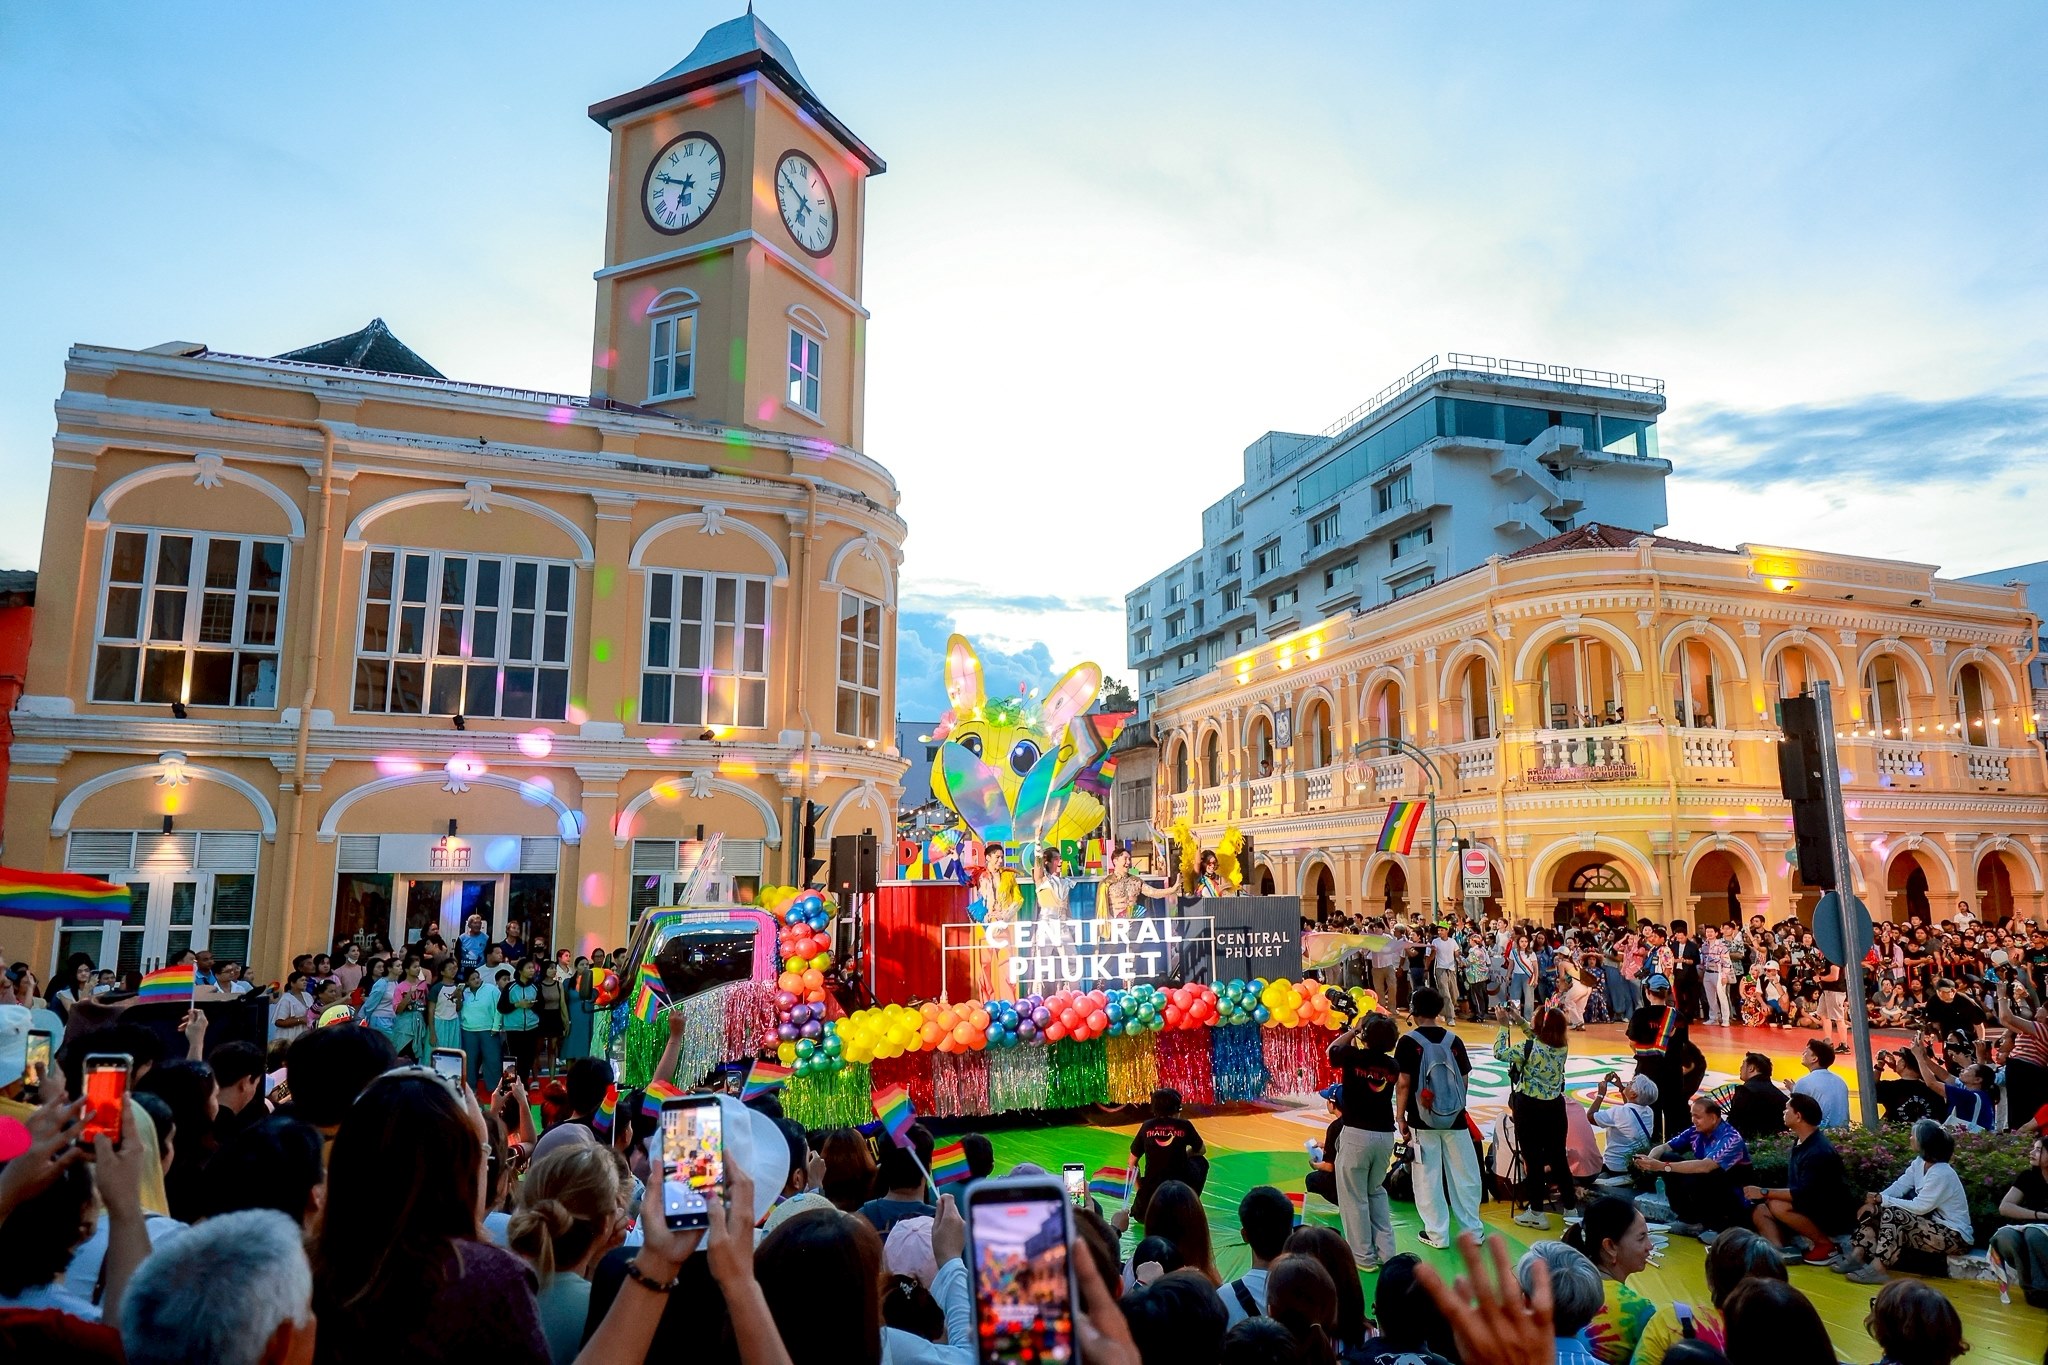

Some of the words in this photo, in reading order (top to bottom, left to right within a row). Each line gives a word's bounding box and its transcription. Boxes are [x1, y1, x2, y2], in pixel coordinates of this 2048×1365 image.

[1797, 562, 1881, 582] CHARTERED
[1887, 572, 1922, 586] BANK
[1225, 945, 1282, 958] PHUKET
[1009, 951, 1162, 983] PHUKET
[1146, 1130, 1185, 1138] THAILAND
